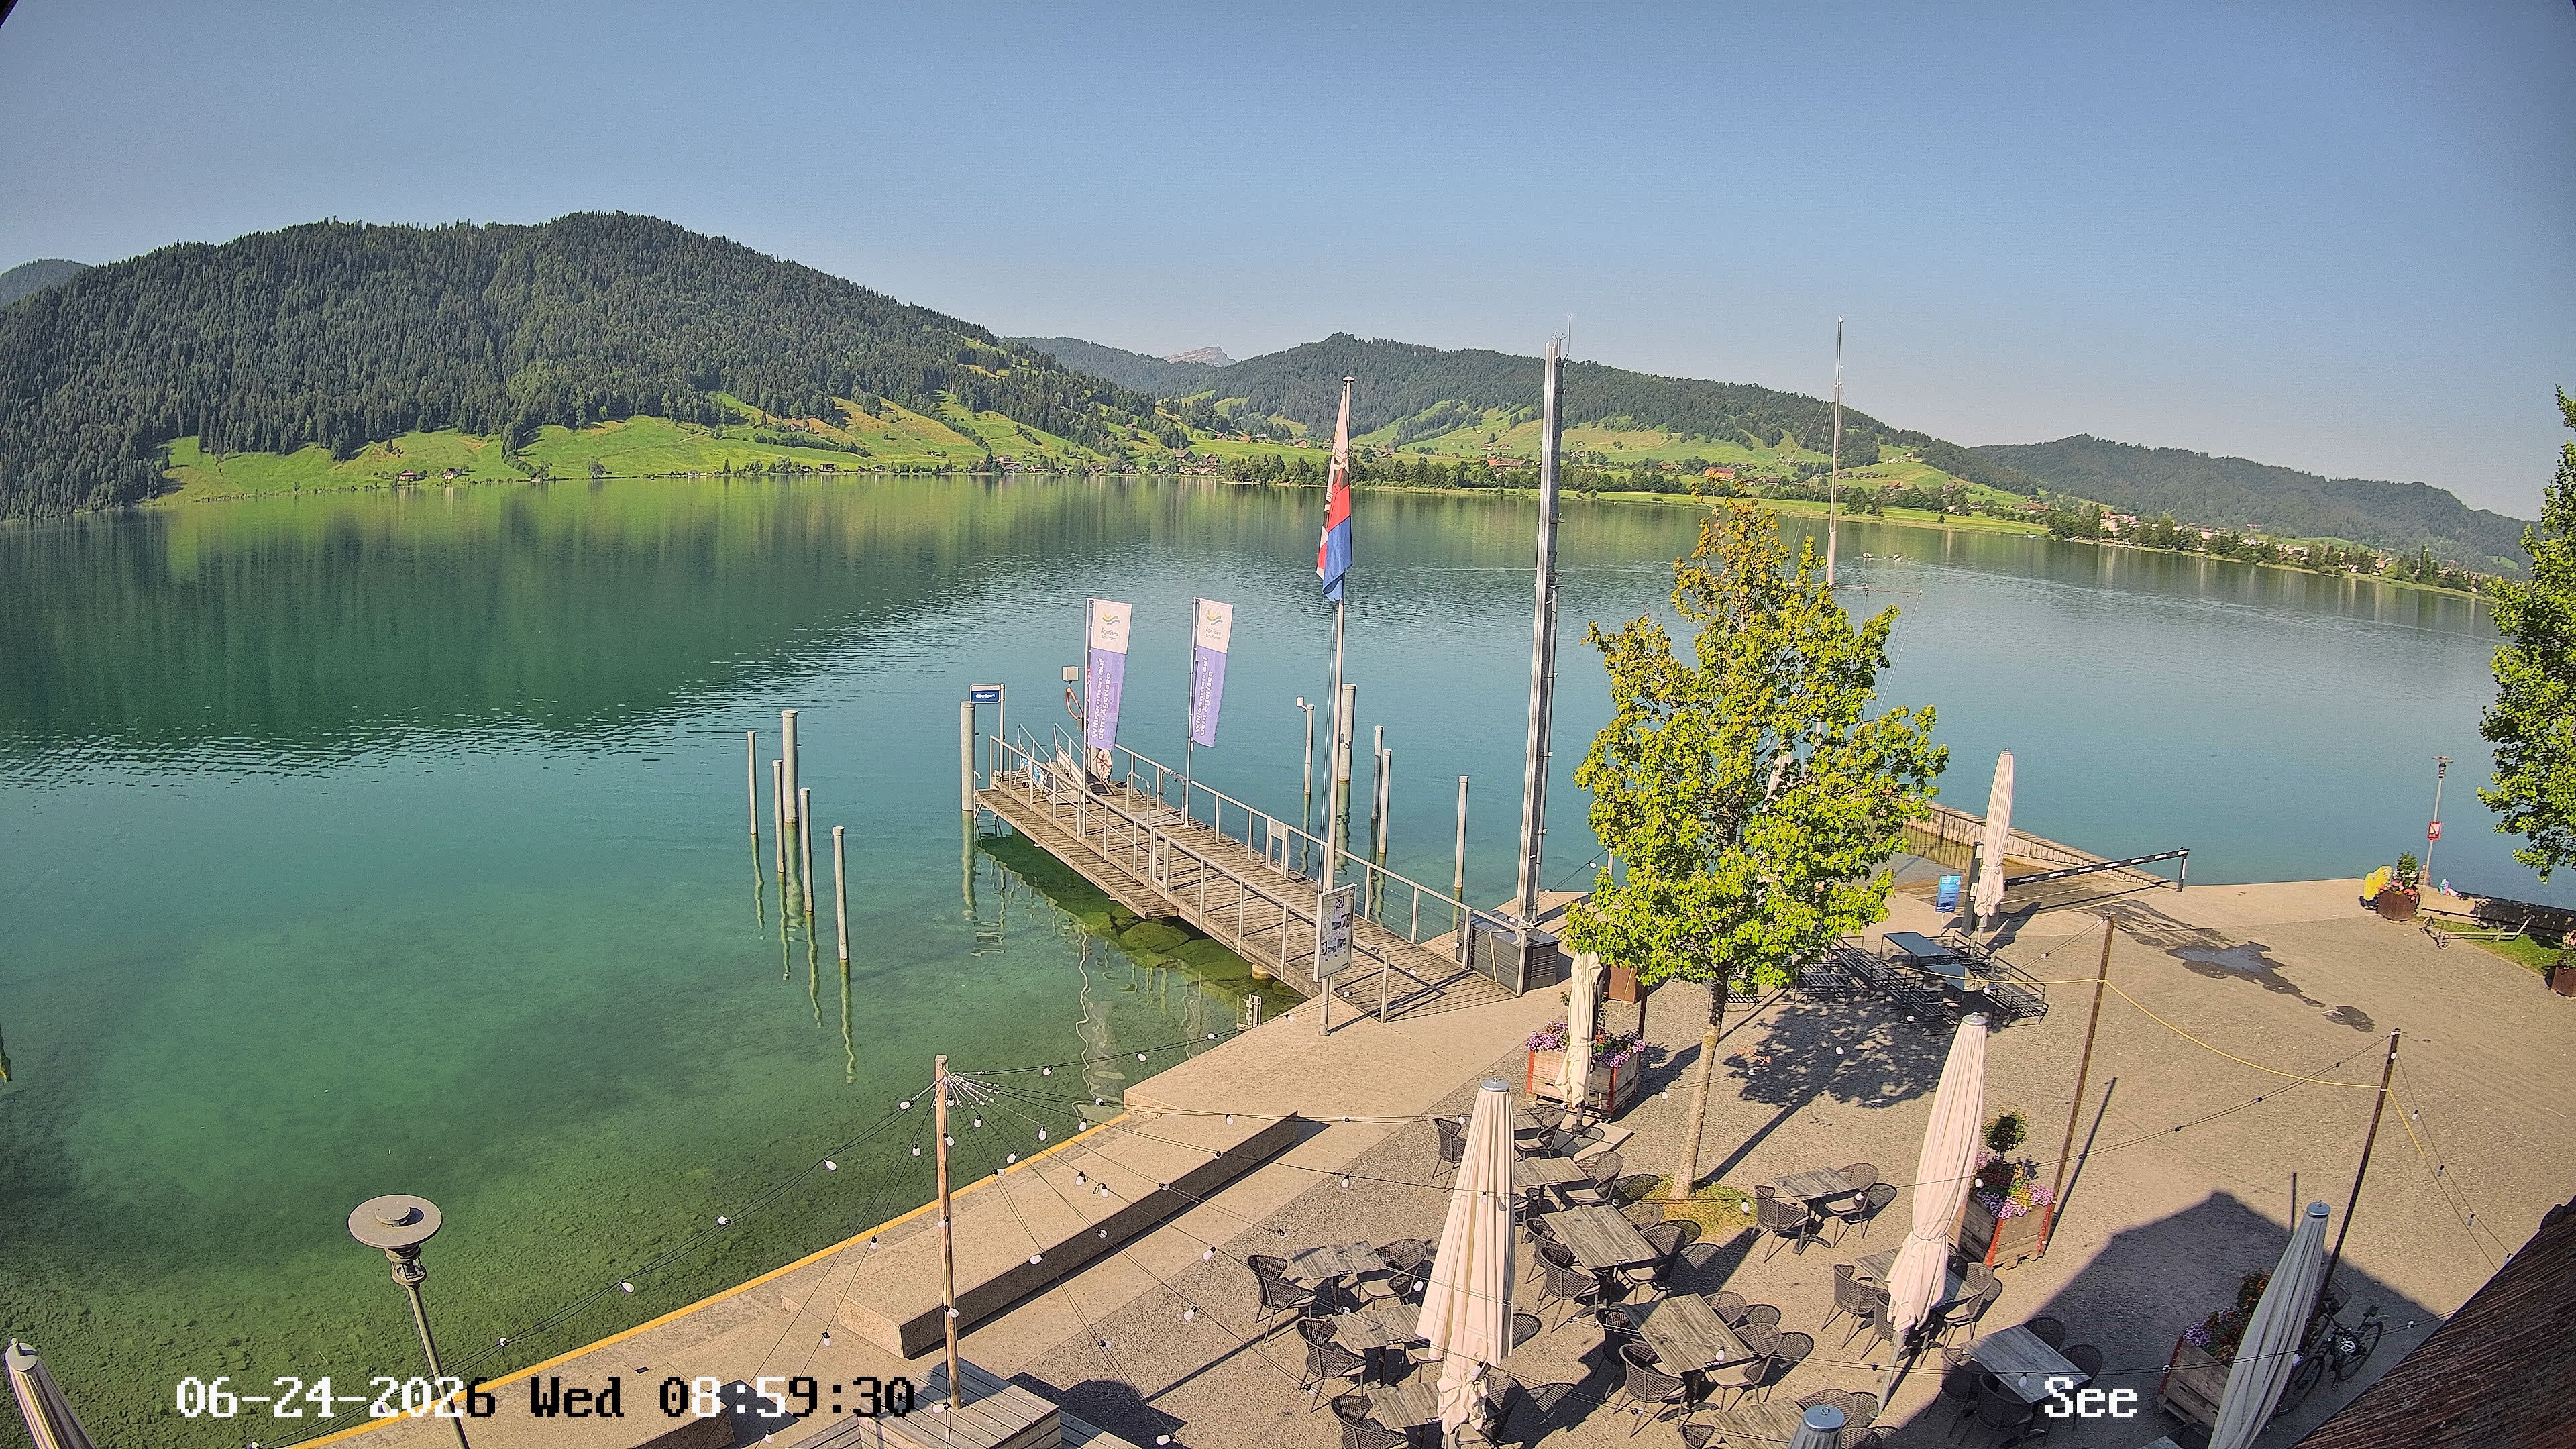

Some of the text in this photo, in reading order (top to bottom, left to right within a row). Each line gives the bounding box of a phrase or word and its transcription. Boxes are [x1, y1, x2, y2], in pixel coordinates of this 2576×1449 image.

[1091, 676, 1103, 737] Willkommen
[1100, 672, 1111, 716] Ägerisee
[1195, 674, 1205, 733] Willkommen
[1201, 671, 1213, 713] Ägerisee
